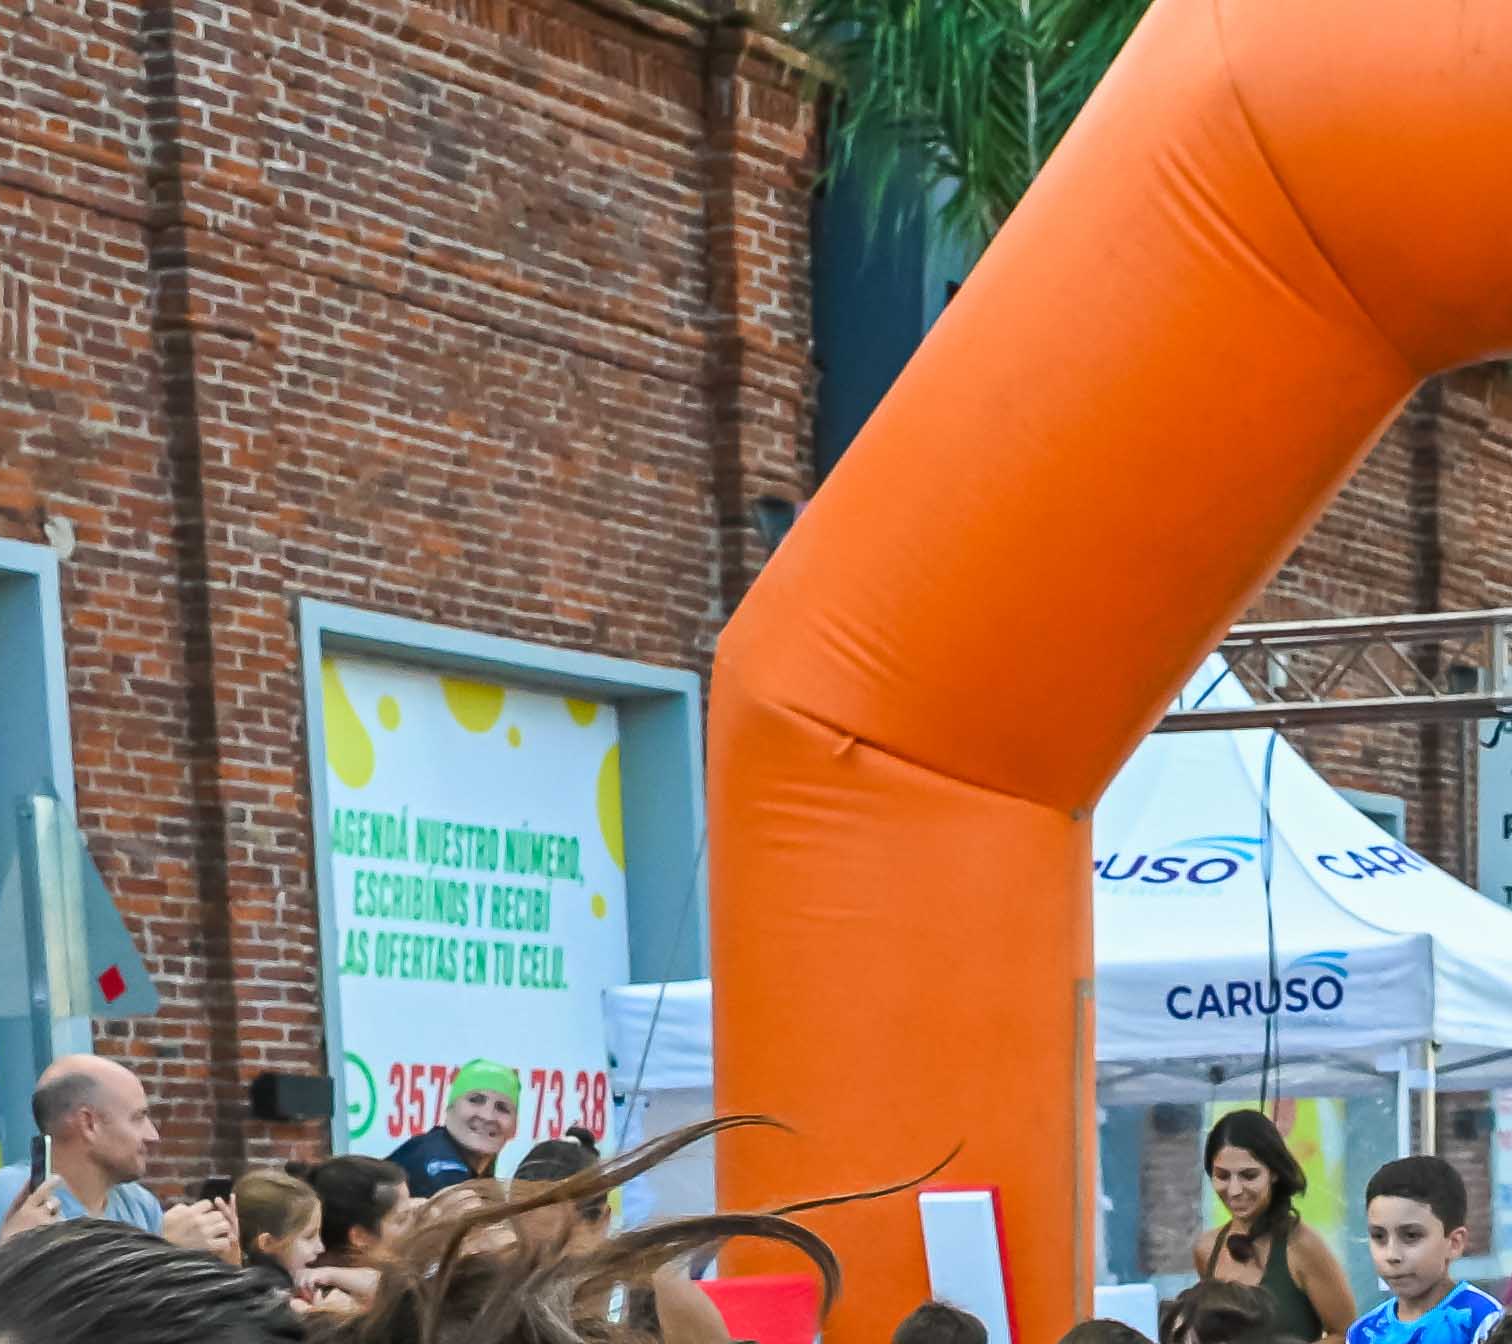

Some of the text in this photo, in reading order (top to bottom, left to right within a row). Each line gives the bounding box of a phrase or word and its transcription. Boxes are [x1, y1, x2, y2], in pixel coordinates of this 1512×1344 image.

[415, 817, 499, 872] NUESTRO
[1094, 853, 1239, 884] USO
[474, 883, 487, 928] Y
[375, 930, 458, 984] OFERTAS
[463, 940, 488, 985] EN
[494, 942, 515, 987] TU
[1166, 975, 1343, 1020] CARUSO
[387, 1062, 459, 1139] 357
